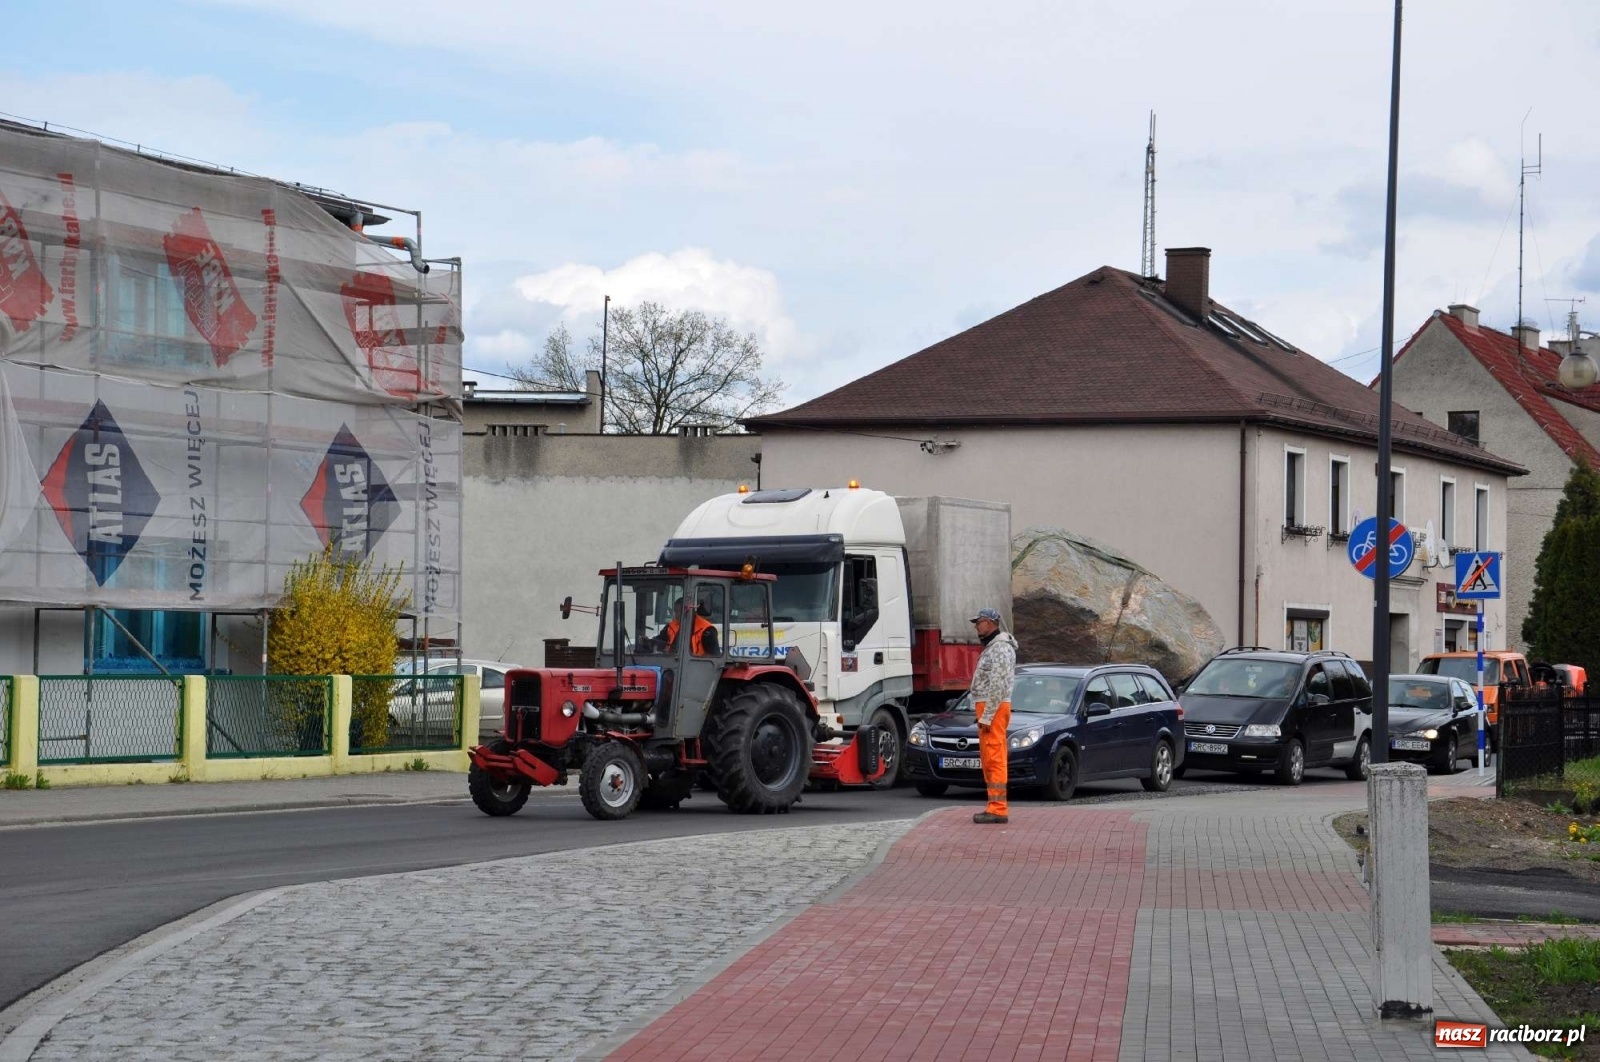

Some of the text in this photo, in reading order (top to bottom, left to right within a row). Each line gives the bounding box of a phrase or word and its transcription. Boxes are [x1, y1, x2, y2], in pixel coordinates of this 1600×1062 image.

[84, 443, 123, 544] ATLAS
[184, 390, 207, 602] MOŻESZ WIĘCEJ
[334, 463, 370, 552] ATLAS
[1411, 741, 1429, 749] EE64
